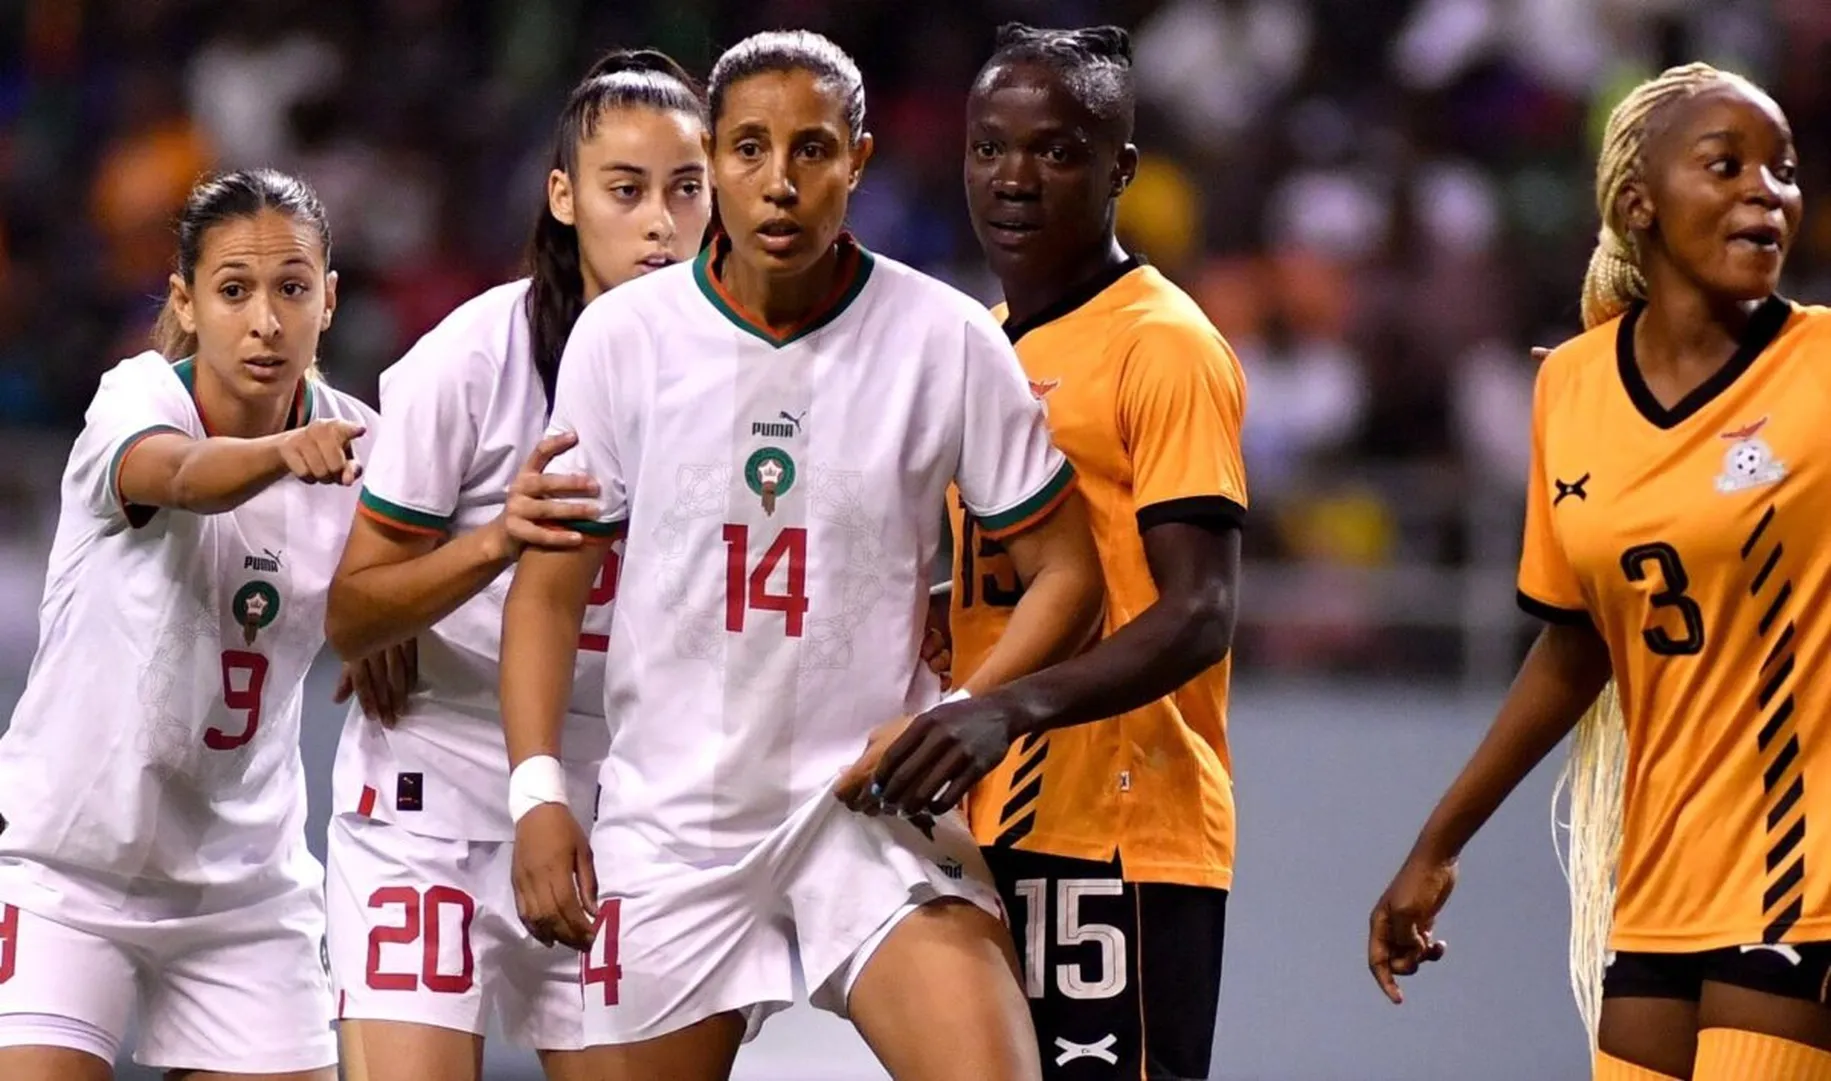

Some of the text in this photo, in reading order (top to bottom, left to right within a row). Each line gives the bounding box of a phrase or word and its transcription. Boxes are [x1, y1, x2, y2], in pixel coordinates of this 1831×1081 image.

[752, 422, 794, 438] PUMA
[243, 555, 279, 573] PUMA
[723, 523, 808, 638] 14
[1621, 542, 1704, 655] 3
[204, 650, 268, 749] 9
[366, 885, 475, 994] 20
[1015, 878, 1127, 1000] 15
